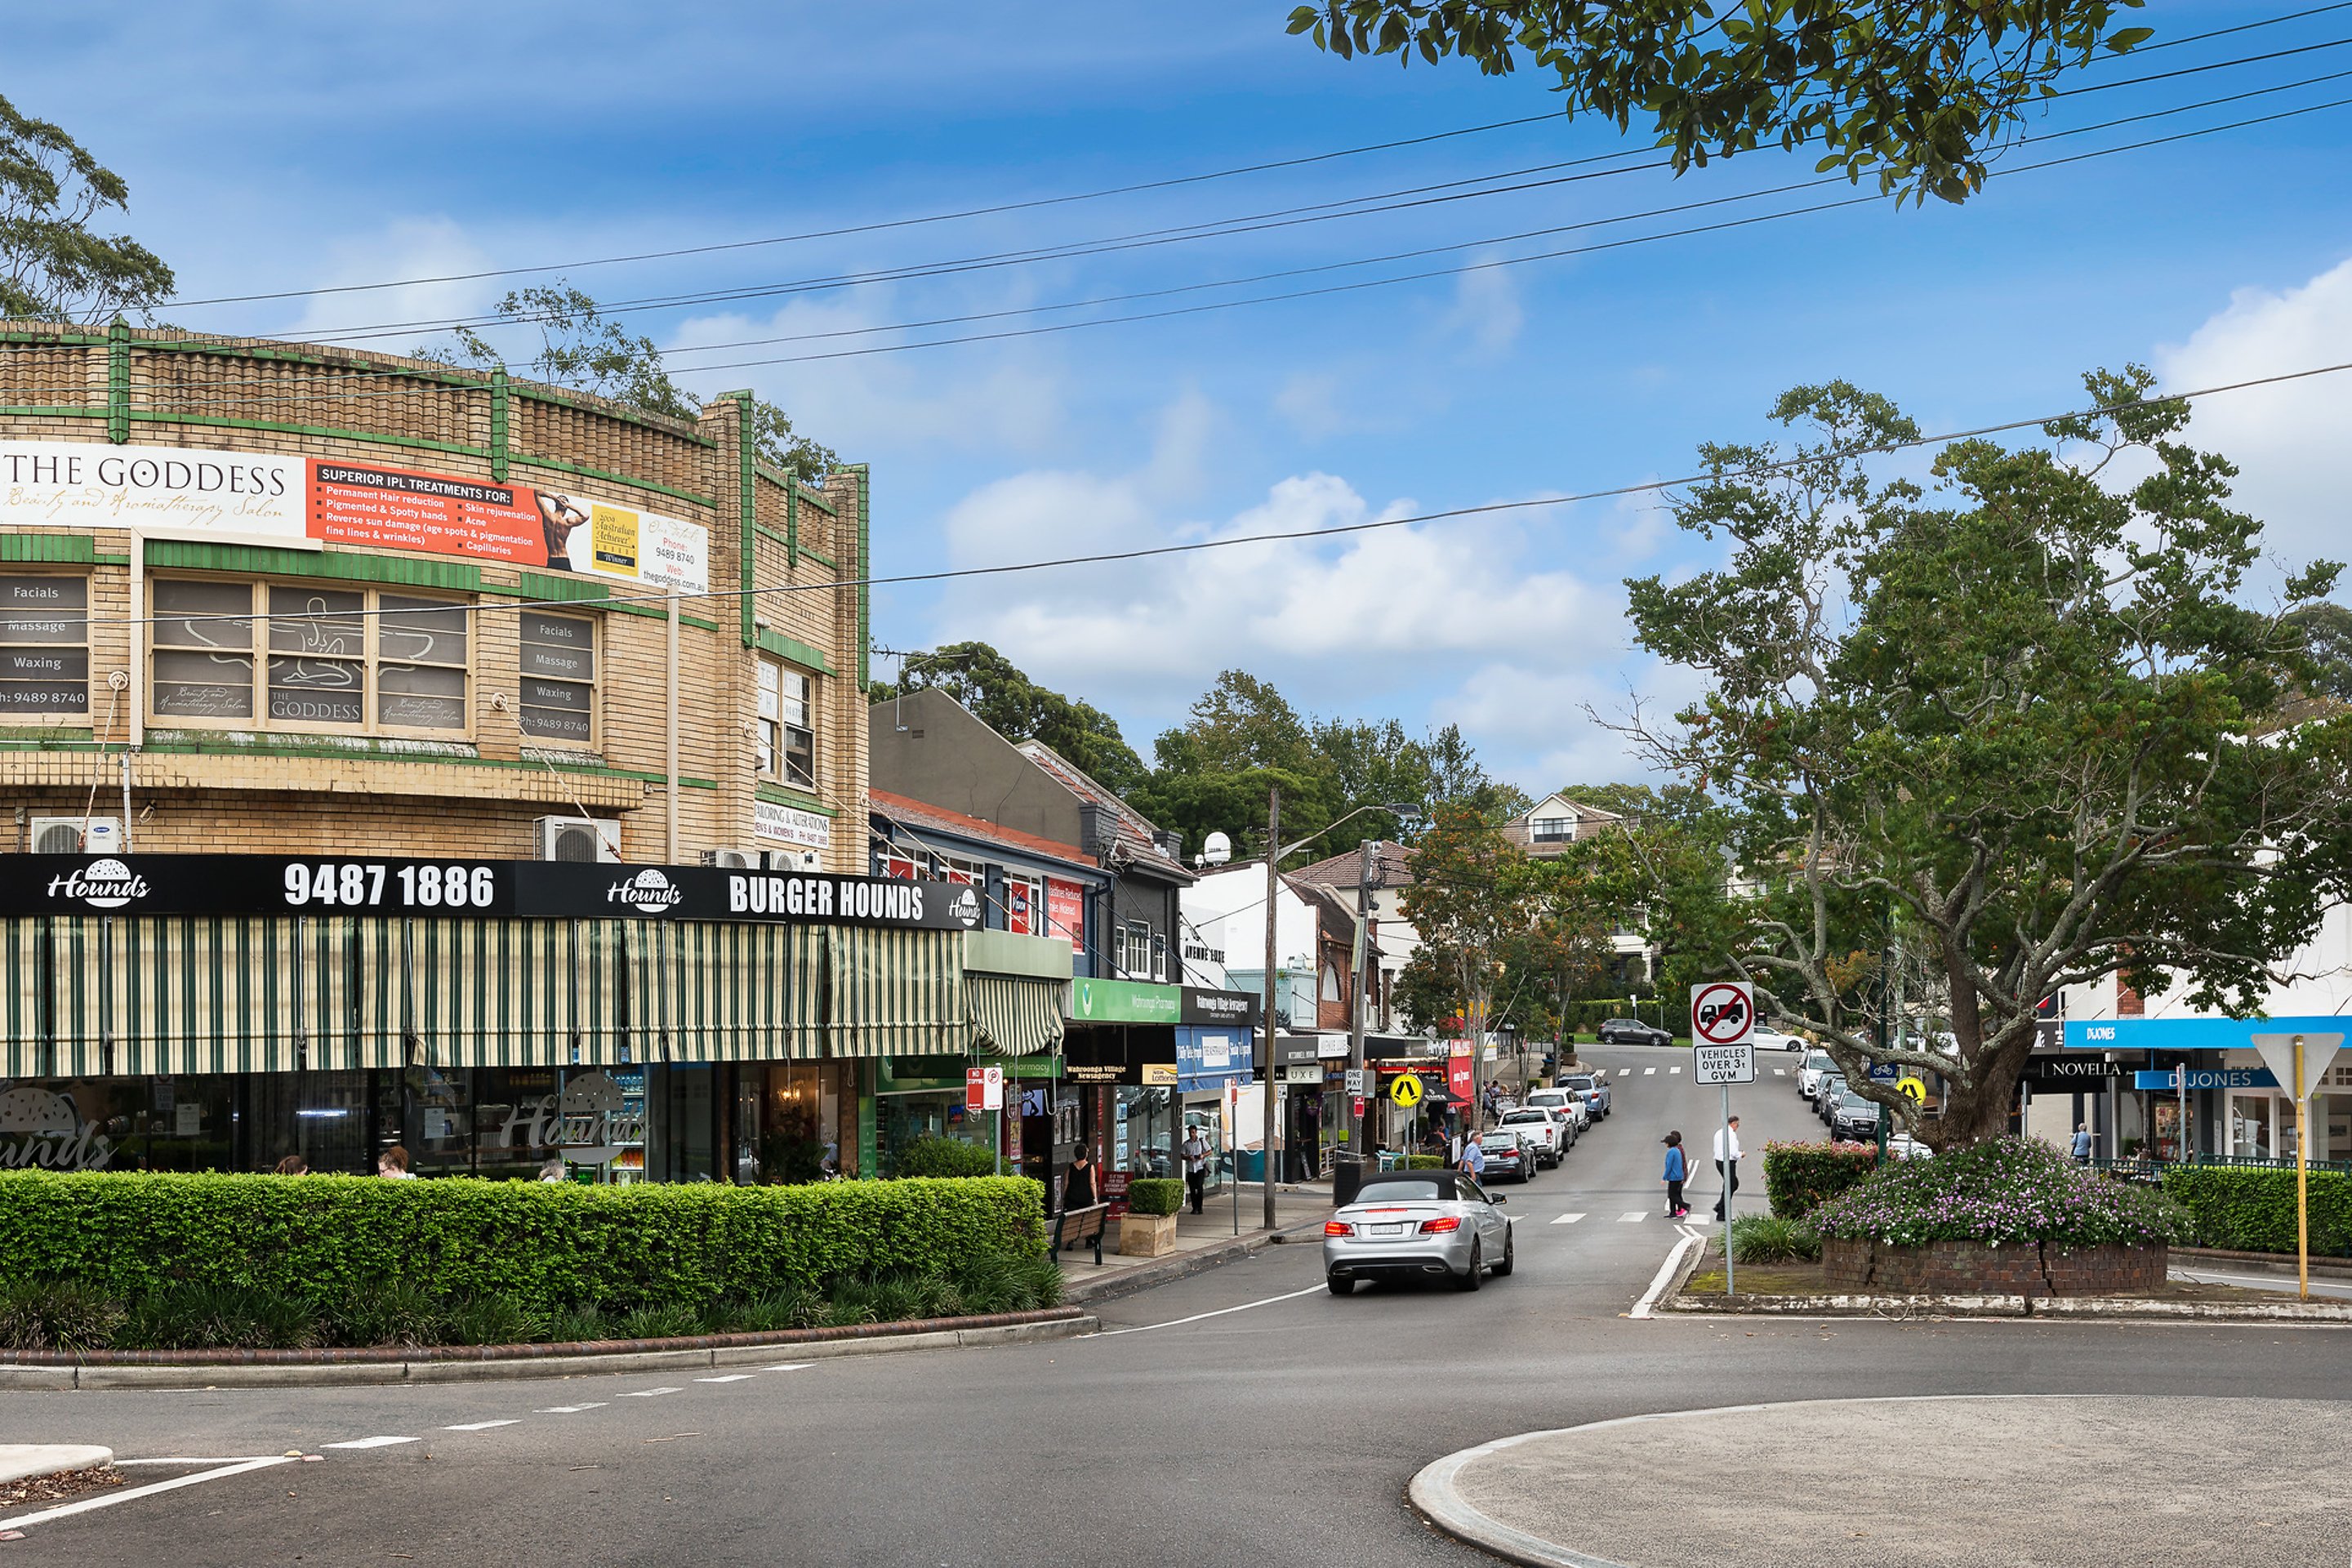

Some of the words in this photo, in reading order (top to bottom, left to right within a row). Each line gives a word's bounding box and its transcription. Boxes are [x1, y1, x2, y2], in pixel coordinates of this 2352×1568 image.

[3, 454, 82, 484] THE
[98, 457, 285, 497] GODDESS
[322, 468, 384, 486] SUPERIOR
[387, 475, 406, 488] IPL
[408, 479, 483, 499] TREATMENTS
[485, 490, 510, 503] FOR:
[326, 485, 378, 501] Permanent
[380, 492, 400, 503] Hair
[403, 495, 444, 508] reduction
[3, 486, 66, 519] Beauty
[72, 488, 105, 506] and
[109, 486, 223, 526] Aromatherapy
[233, 496, 283, 518] Salon
[326, 499, 377, 513] Pigmented
[380, 505, 388, 514] &
[390, 506, 419, 519] Spotty
[421, 510, 448, 521] hands
[465, 502, 484, 514] Skin
[487, 507, 536, 522] rejuvenation
[326, 512, 363, 525] Reverse
[366, 519, 383, 527] sun
[385, 519, 421, 532] damage
[423, 523, 443, 535] (age
[445, 527, 469, 538] spots
[470, 529, 478, 538] &
[479, 531, 533, 546] pigmentation
[465, 516, 487, 527] Acne
[326, 525, 345, 536] fine
[347, 528, 370, 538] lines
[372, 530, 381, 540] &
[383, 532, 425, 546] wrinkles)
[466, 541, 512, 555] Capillaries
[663, 537, 688, 552] Phone:
[656, 547, 675, 561] 9489
[676, 550, 695, 565] 8740
[666, 564, 684, 577] Web:
[14, 586, 59, 599] Facials
[8, 621, 66, 633] Massage
[540, 624, 572, 638] Facials
[14, 657, 62, 670] Waxing
[536, 654, 578, 670] Massage
[14, 693, 47, 704] 9489
[51, 693, 86, 704] 8740
[537, 686, 572, 702] Waxing
[271, 701, 360, 719] GODDESS
[519, 715, 535, 727] Ph:
[537, 718, 562, 730] 9489
[564, 720, 589, 733] 8740
[47, 869, 151, 899] Hounds
[284, 863, 385, 906] 9487
[398, 865, 494, 907] 1886
[607, 878, 683, 906] Hounds
[729, 875, 833, 916] BURGER
[840, 882, 924, 921] HOUNDS
[1185, 944, 1209, 962] AVENUE
[1210, 948, 1225, 964] LUXE
[1700, 1049, 1746, 1059] VEHICLES
[1067, 1065, 1102, 1074] Wahroonga
[1104, 1065, 1126, 1074] Village
[1702, 1060, 1731, 1070] OVER
[2052, 1062, 2121, 1076] NOVELLA
[1710, 1071, 1737, 1080] GVM
